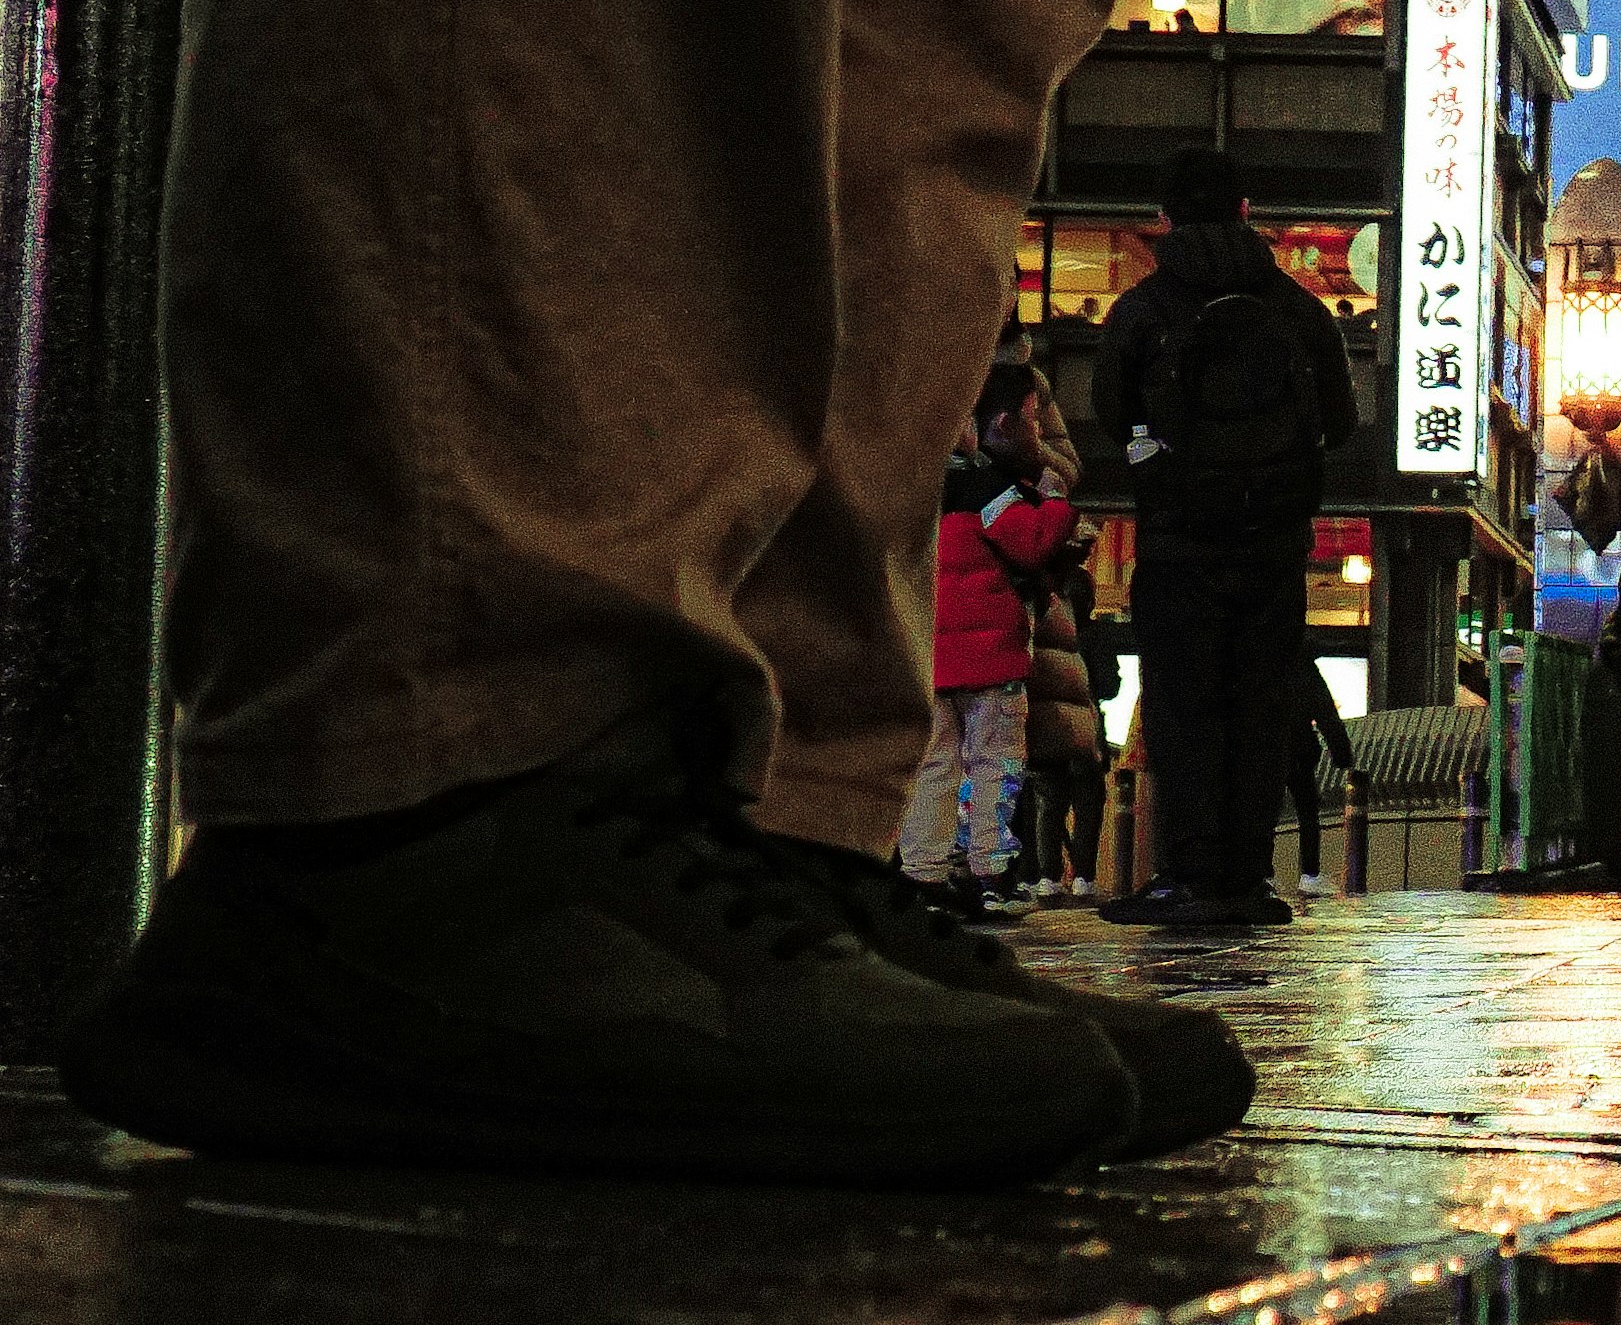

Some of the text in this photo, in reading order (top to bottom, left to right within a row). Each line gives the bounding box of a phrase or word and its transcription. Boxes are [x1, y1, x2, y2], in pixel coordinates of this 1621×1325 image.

[1425, 35, 1466, 198] 本場の味
[1414, 221, 1467, 454] かに道楽
